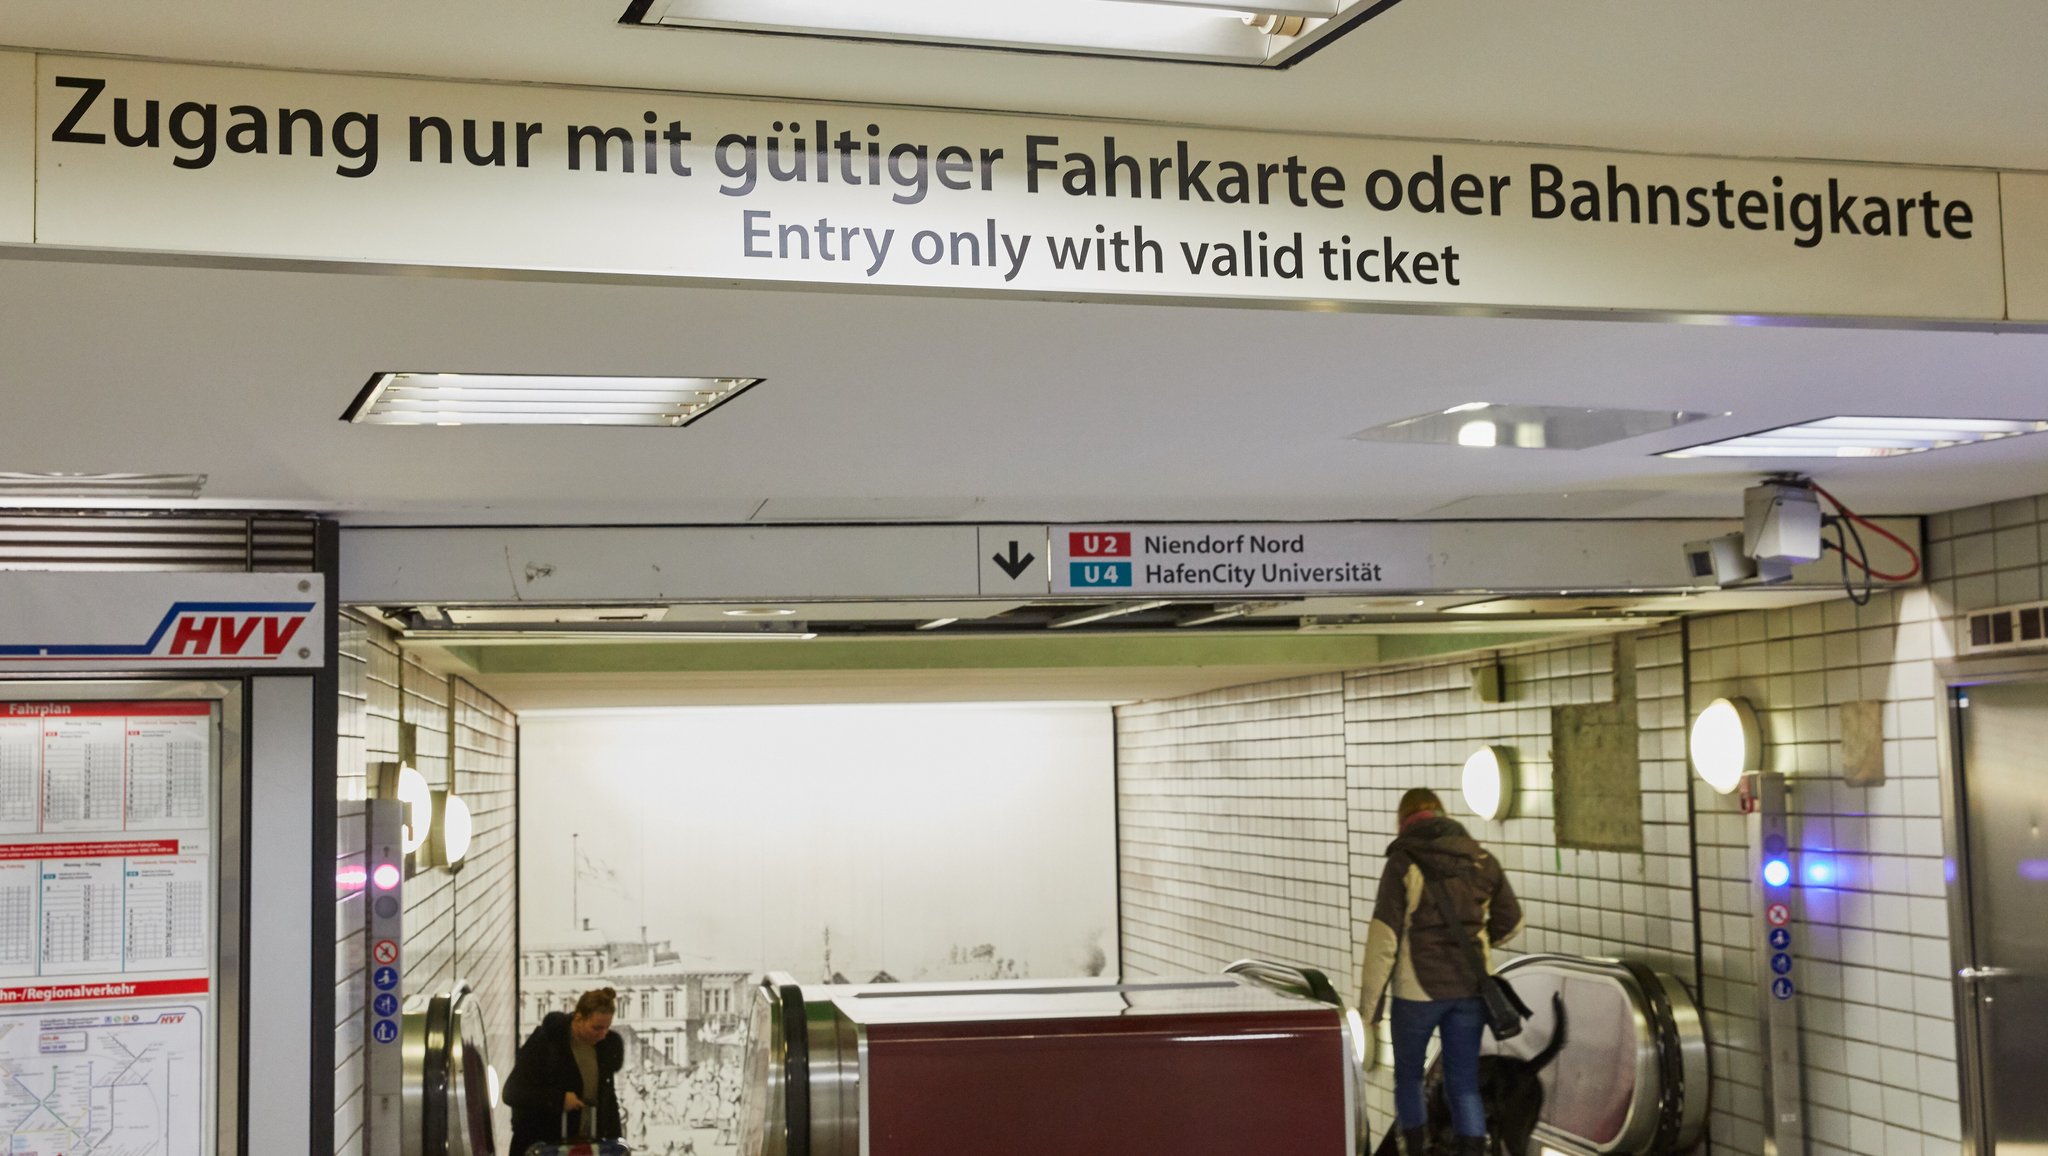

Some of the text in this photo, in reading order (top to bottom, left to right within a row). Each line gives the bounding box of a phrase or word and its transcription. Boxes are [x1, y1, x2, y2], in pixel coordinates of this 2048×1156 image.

[51, 75, 1974, 249] Zugang nur mit gültiger Fahrkarte oder Bahnsteigkarte
[742, 209, 1461, 287] Entry only with valid ticket
[1083, 533, 1306, 556] U2 Niendorf Nord
[1084, 560, 1383, 589] U4 HafenCity Universität
[168, 616, 306, 656] HVV
[9, 703, 71, 717] Fahrplan
[159, 1015, 185, 1025] HVV
